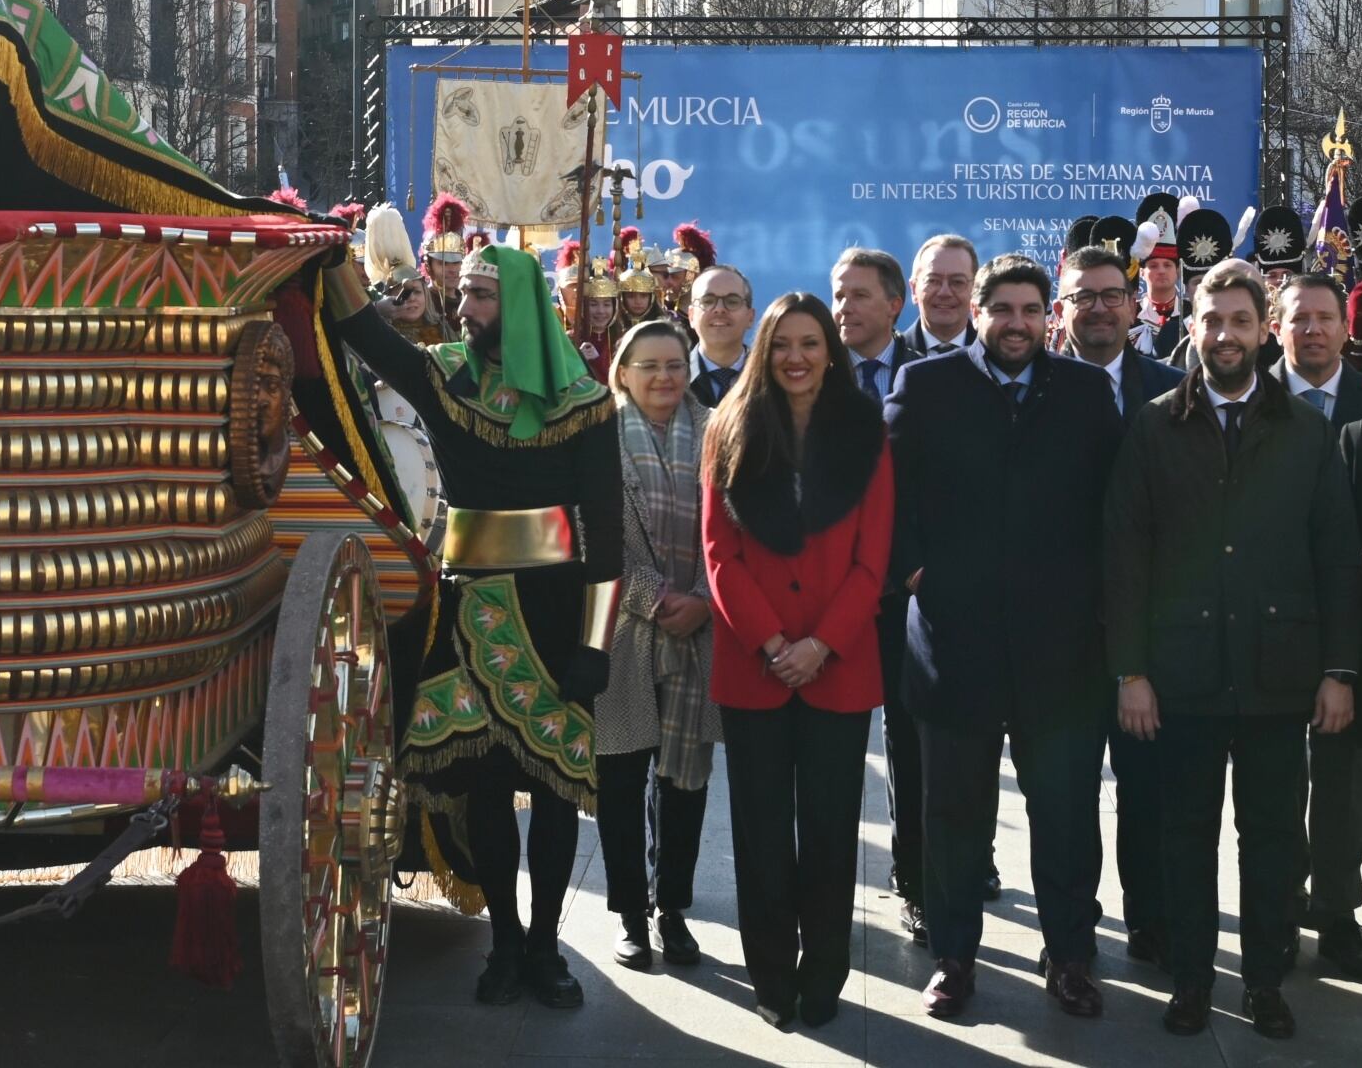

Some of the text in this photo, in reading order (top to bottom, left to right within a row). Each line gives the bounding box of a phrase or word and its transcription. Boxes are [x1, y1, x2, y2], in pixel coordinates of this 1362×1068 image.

[579, 43, 613, 56] S P
[606, 69, 613, 82] R
[627, 97, 763, 126] MURCIA
[1007, 108, 1048, 119] REGIÓN
[1120, 107, 1149, 116] Región
[1186, 108, 1214, 116] Murcia
[1007, 119, 1067, 128] DE MURCIA
[954, 163, 1214, 182] FIESTAS DE SEMANA SANTA
[852, 183, 876, 199] DE
[882, 180, 957, 200] INTERÉS
[963, 180, 1064, 200] TURÍSTICO
[983, 217, 1045, 231] SEMANA
